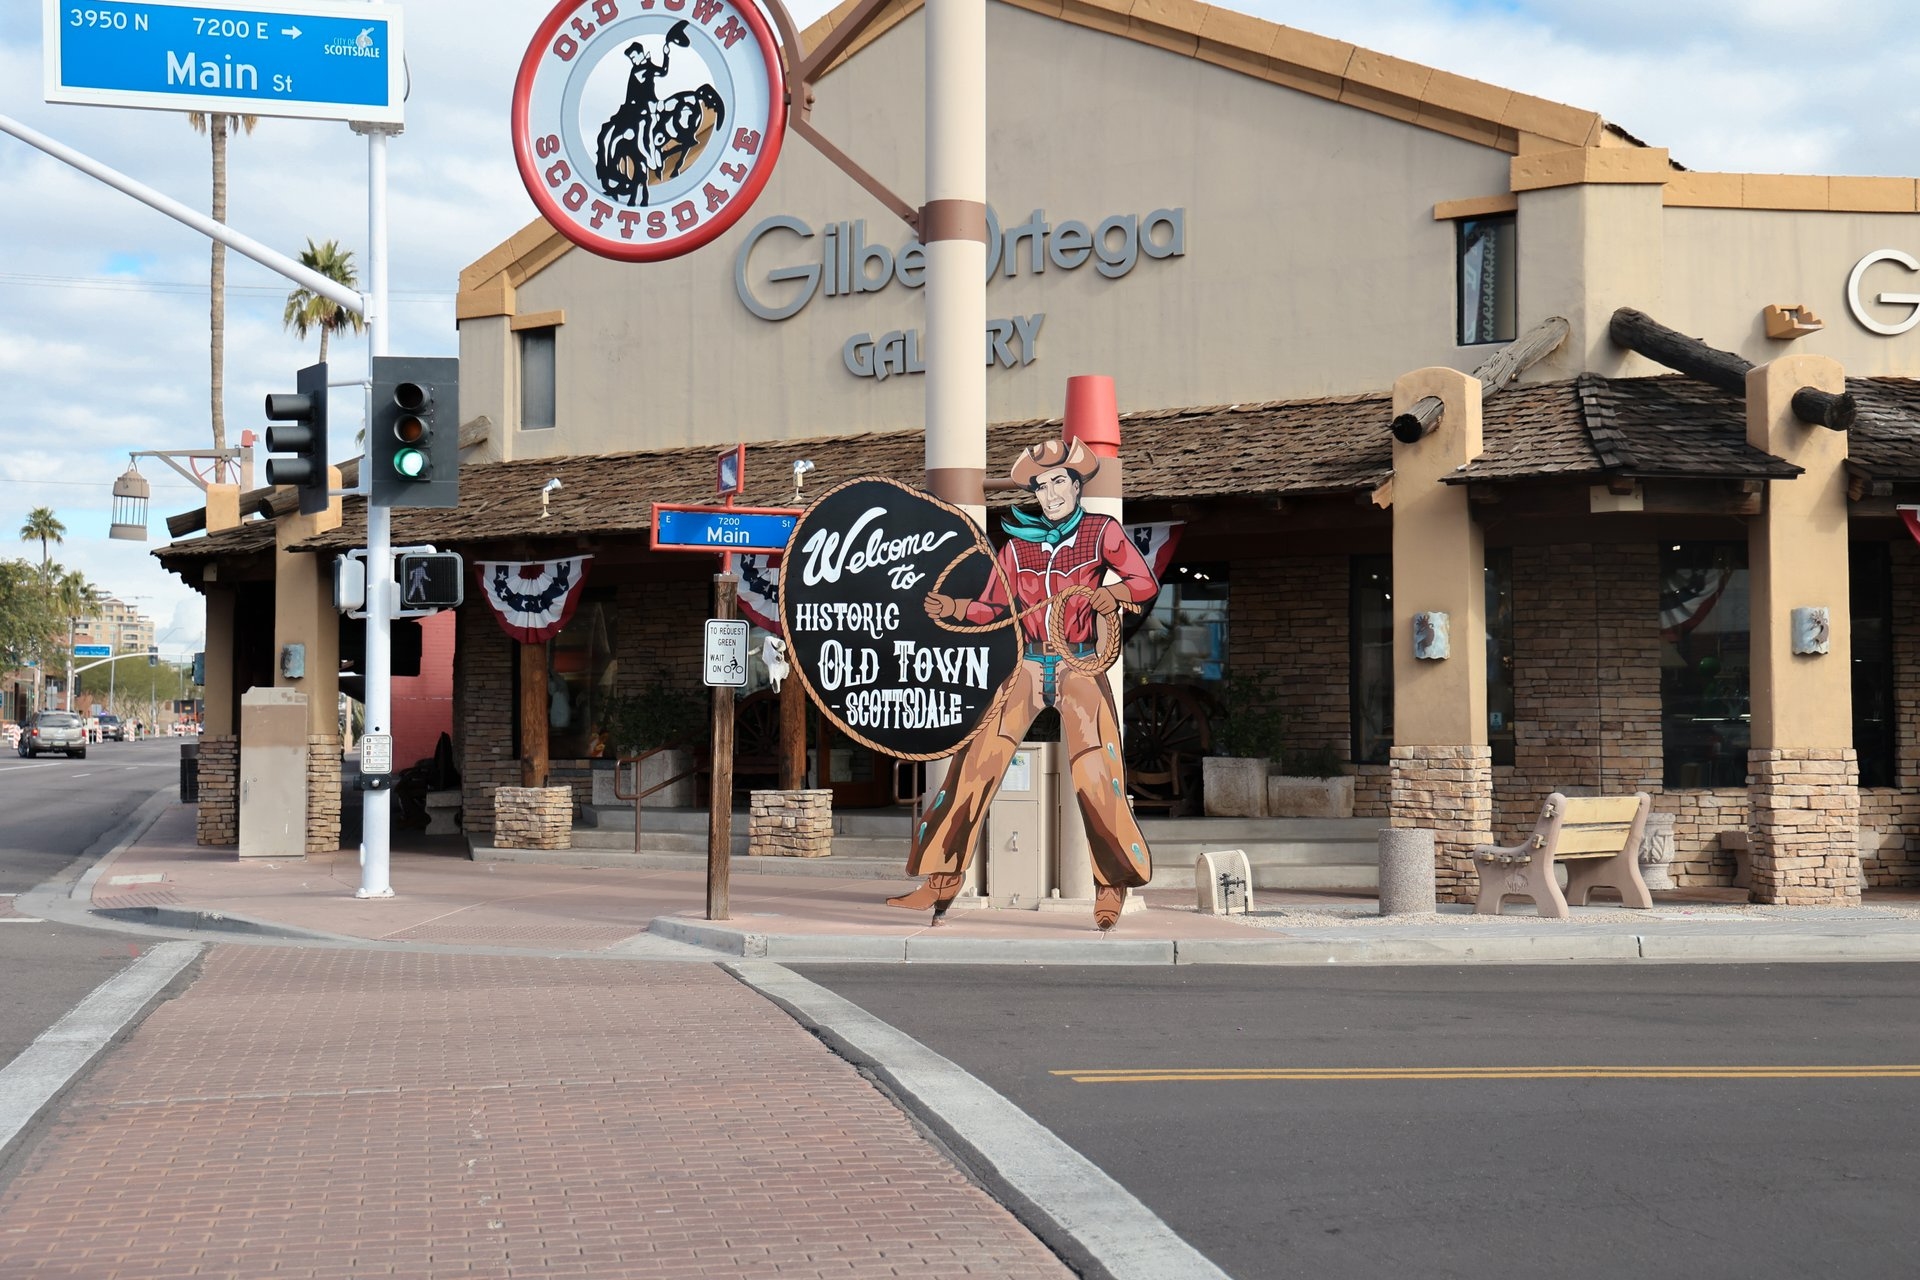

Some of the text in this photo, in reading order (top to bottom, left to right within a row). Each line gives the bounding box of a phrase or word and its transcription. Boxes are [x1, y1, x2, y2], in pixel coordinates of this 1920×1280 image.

[70, 8, 149, 31] 3950 N
[192, 17, 269, 39] 7200 E
[553, 0, 619, 61] OLD
[324, 44, 380, 58] SCOTTSDALE
[333, 37, 355, 46] CITY OF
[166, 50, 292, 92] Main St
[536, 127, 761, 239] SCOTTSDALE
[735, 214, 926, 321] Gilbe
[843, 313, 1046, 381] GALRY
[707, 526, 750, 544] Main
[718, 517, 740, 526] 7200
[802, 506, 958, 586] Welcome
[888, 564, 926, 590] to
[720, 627, 744, 636] REQUEST
[795, 602, 900, 639] HISTORIC
[818, 639, 990, 691] OLD TOWN
[845, 687, 963, 729] SCOTTSDALE
